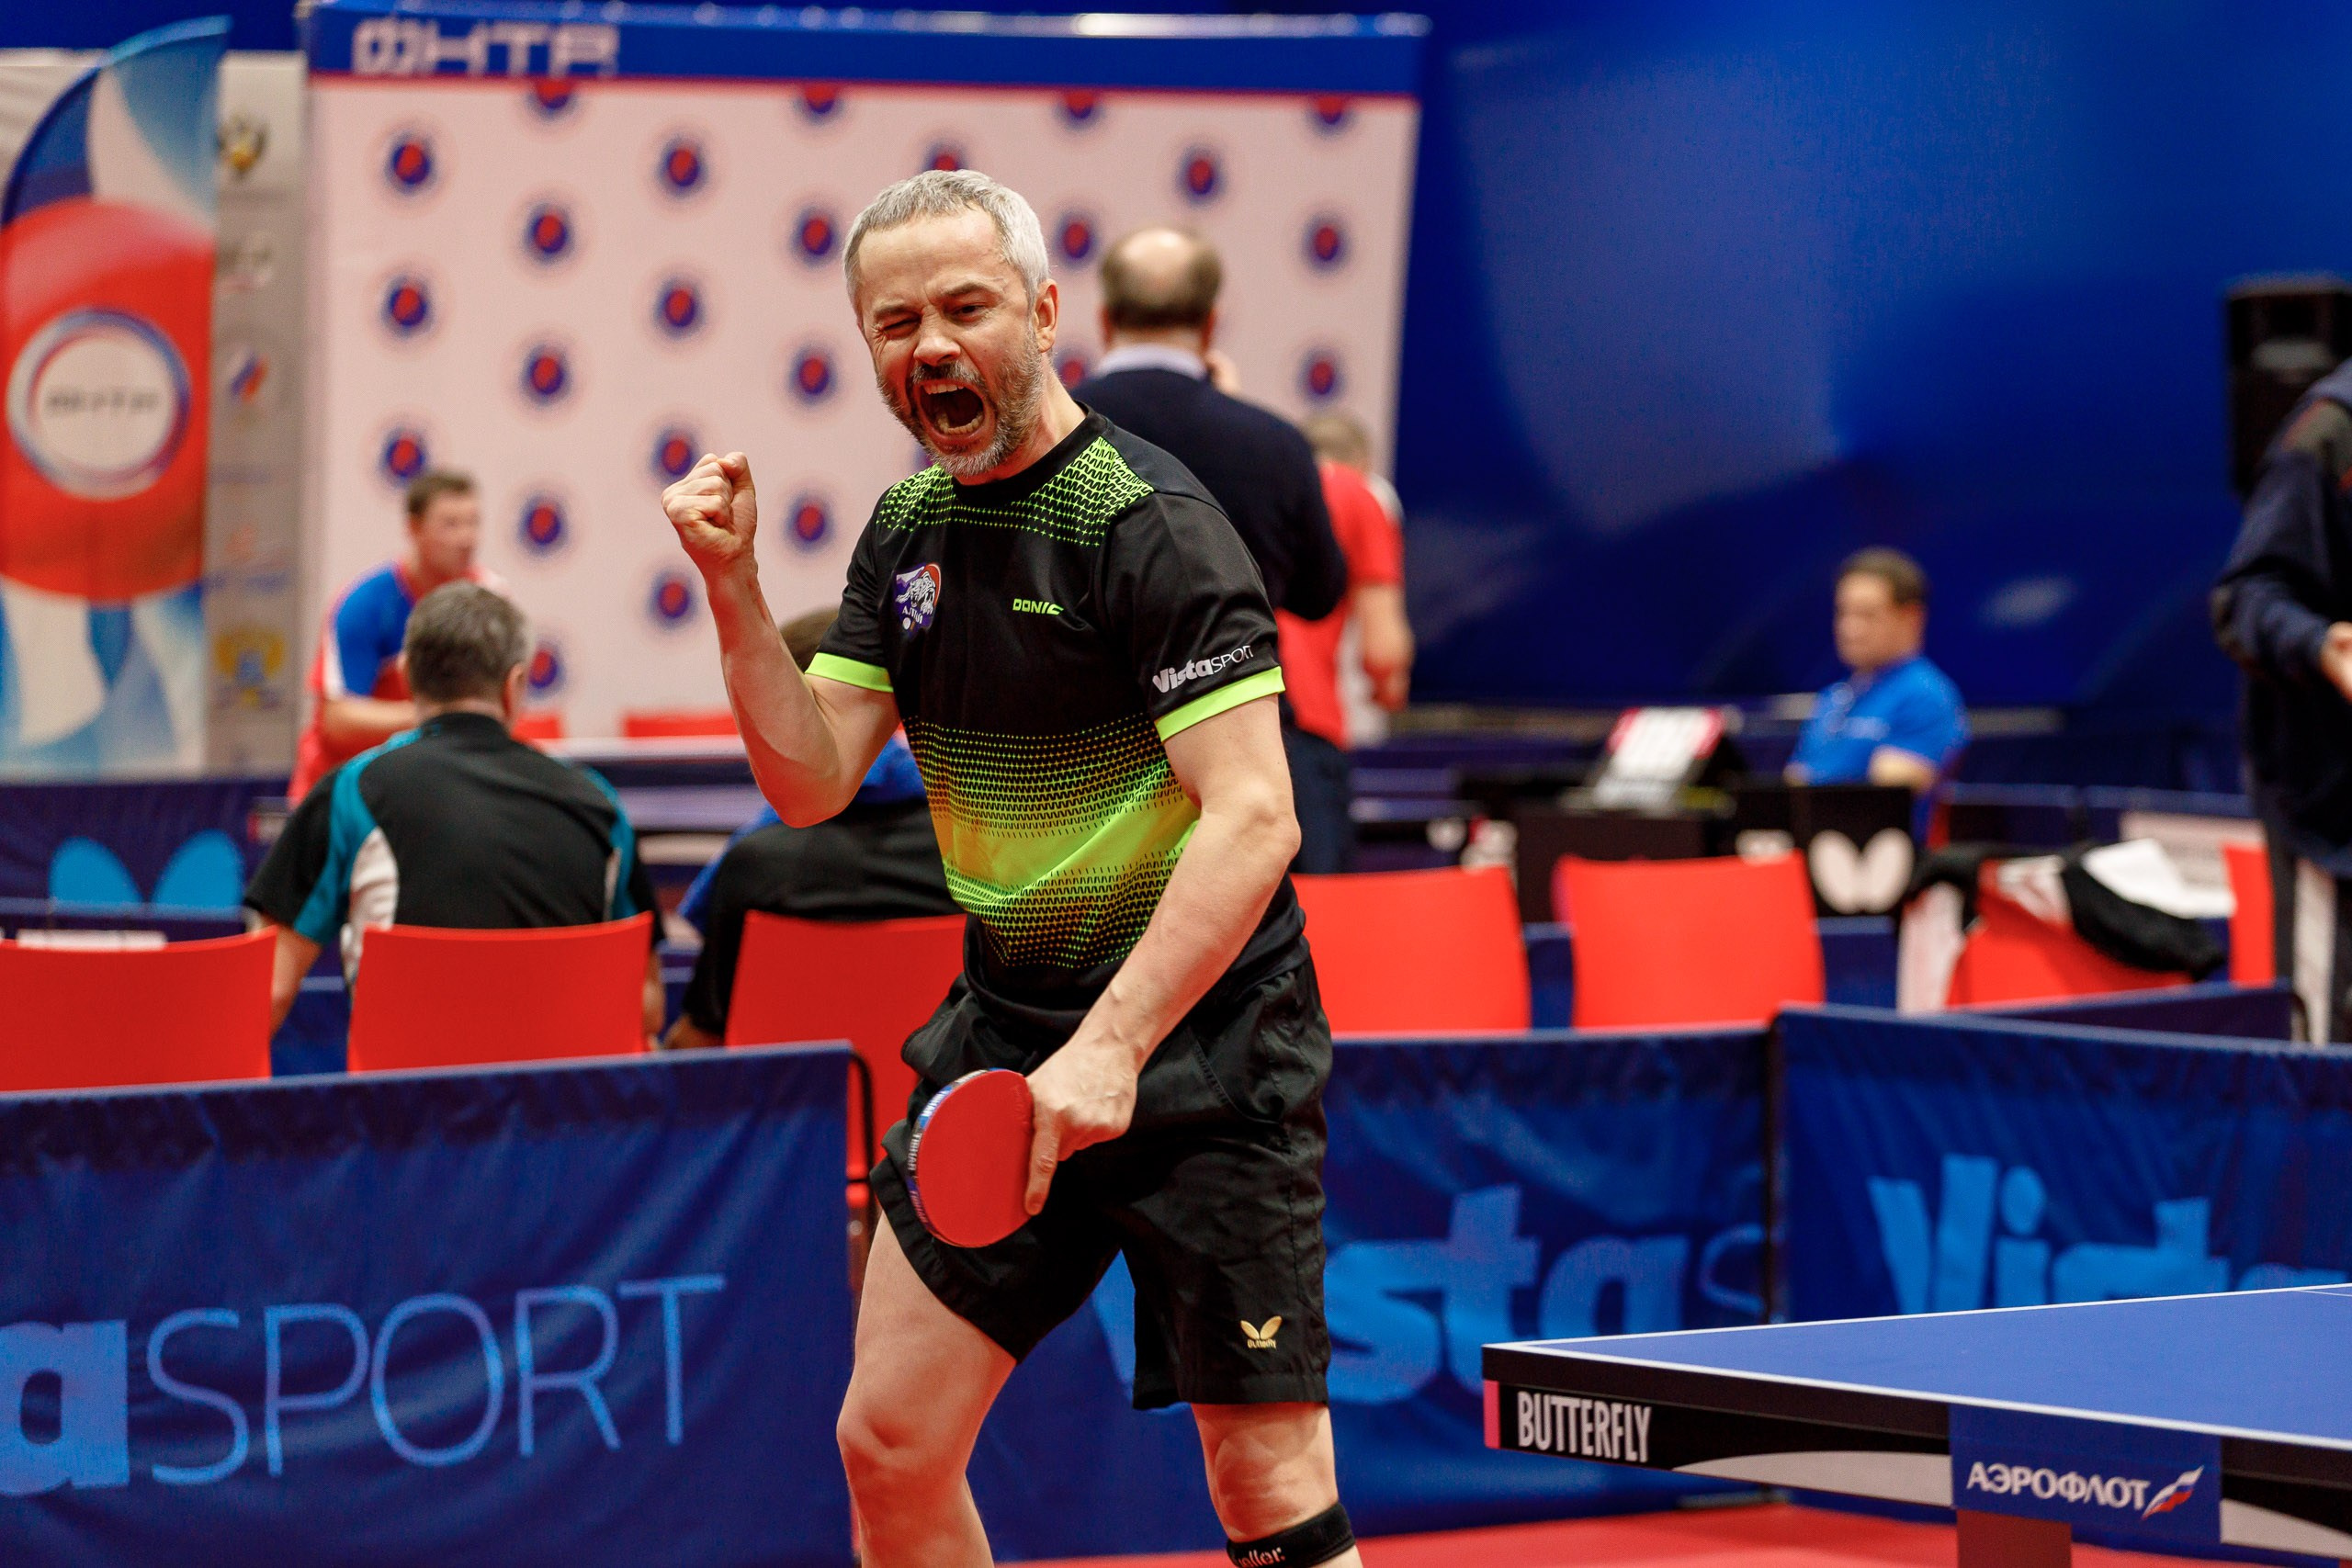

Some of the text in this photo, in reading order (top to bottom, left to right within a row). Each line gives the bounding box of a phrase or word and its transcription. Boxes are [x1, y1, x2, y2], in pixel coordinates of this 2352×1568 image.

[1012, 598, 1064, 615] DONIC
[1517, 1391, 1653, 1463] BUTTERFLY
[1966, 1461, 2152, 1511] АЭРОФЛОТ
